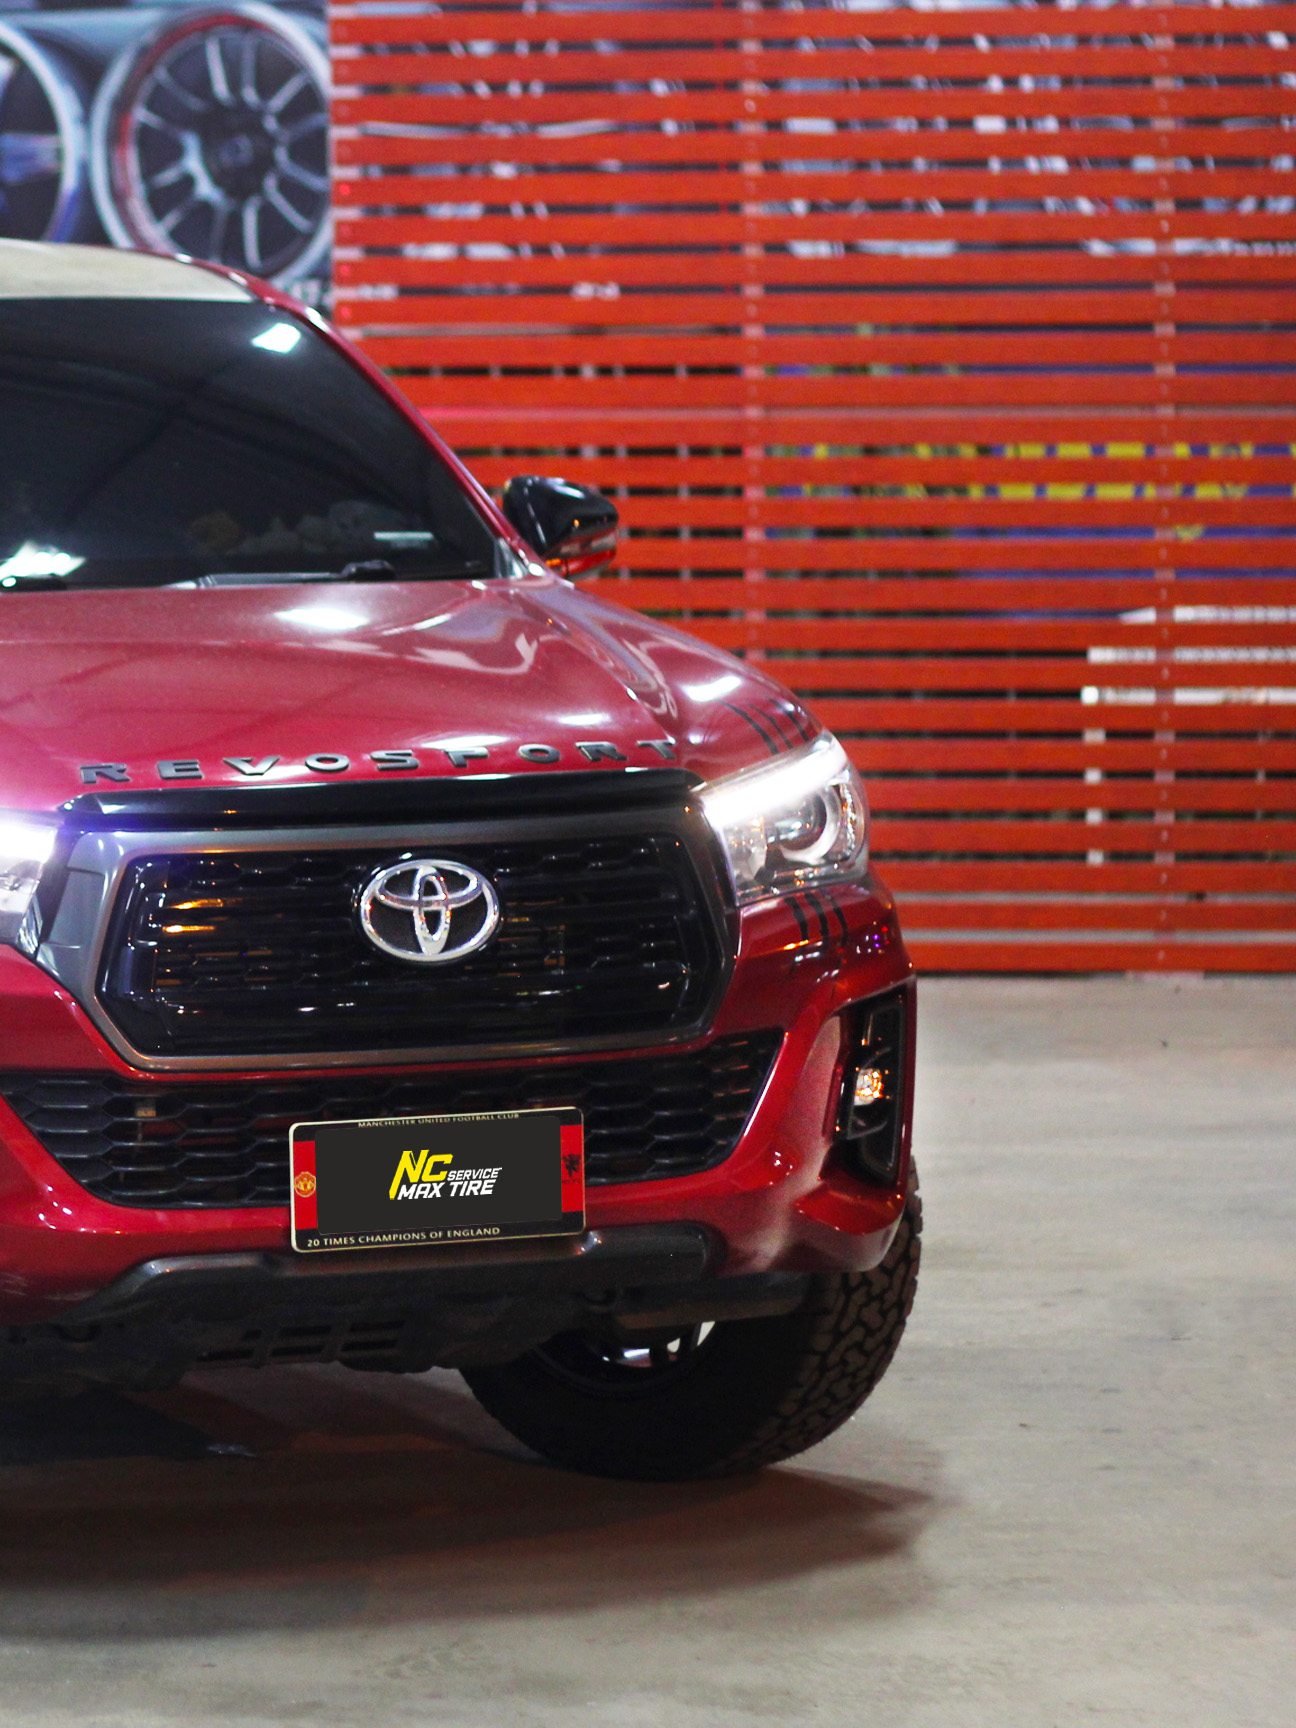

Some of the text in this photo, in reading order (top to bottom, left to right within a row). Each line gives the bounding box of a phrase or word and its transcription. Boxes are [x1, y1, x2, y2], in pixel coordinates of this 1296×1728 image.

[80, 740, 677, 784] REVOSPORT
[358, 1119, 416, 1128] MANCHESTER
[453, 1114, 495, 1122] FOOTBALL
[307, 1227, 501, 1247] 20 TIMES CHAMPIONS OF ENGLAND
